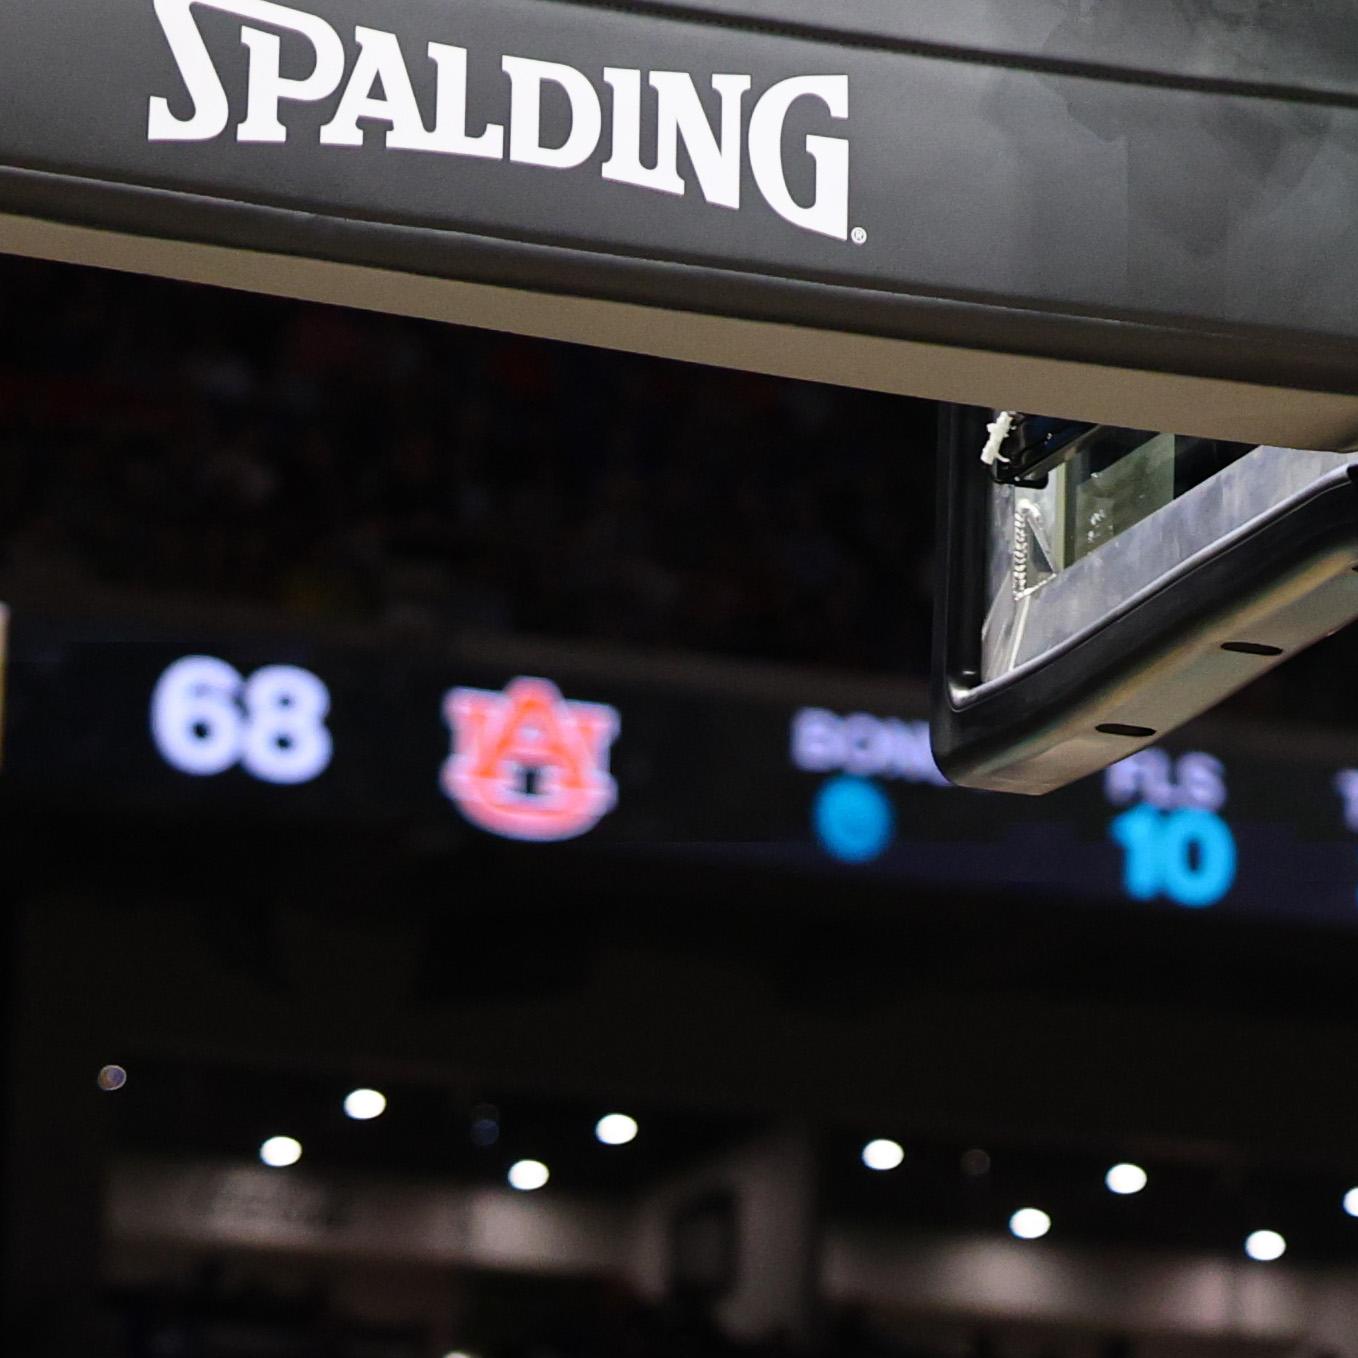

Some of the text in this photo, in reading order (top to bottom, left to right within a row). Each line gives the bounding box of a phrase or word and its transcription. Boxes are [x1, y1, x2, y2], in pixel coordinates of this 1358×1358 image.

[147, 0, 850, 242] SPALDING
[152, 656, 332, 785] 68
[1112, 803, 1237, 908] 10
